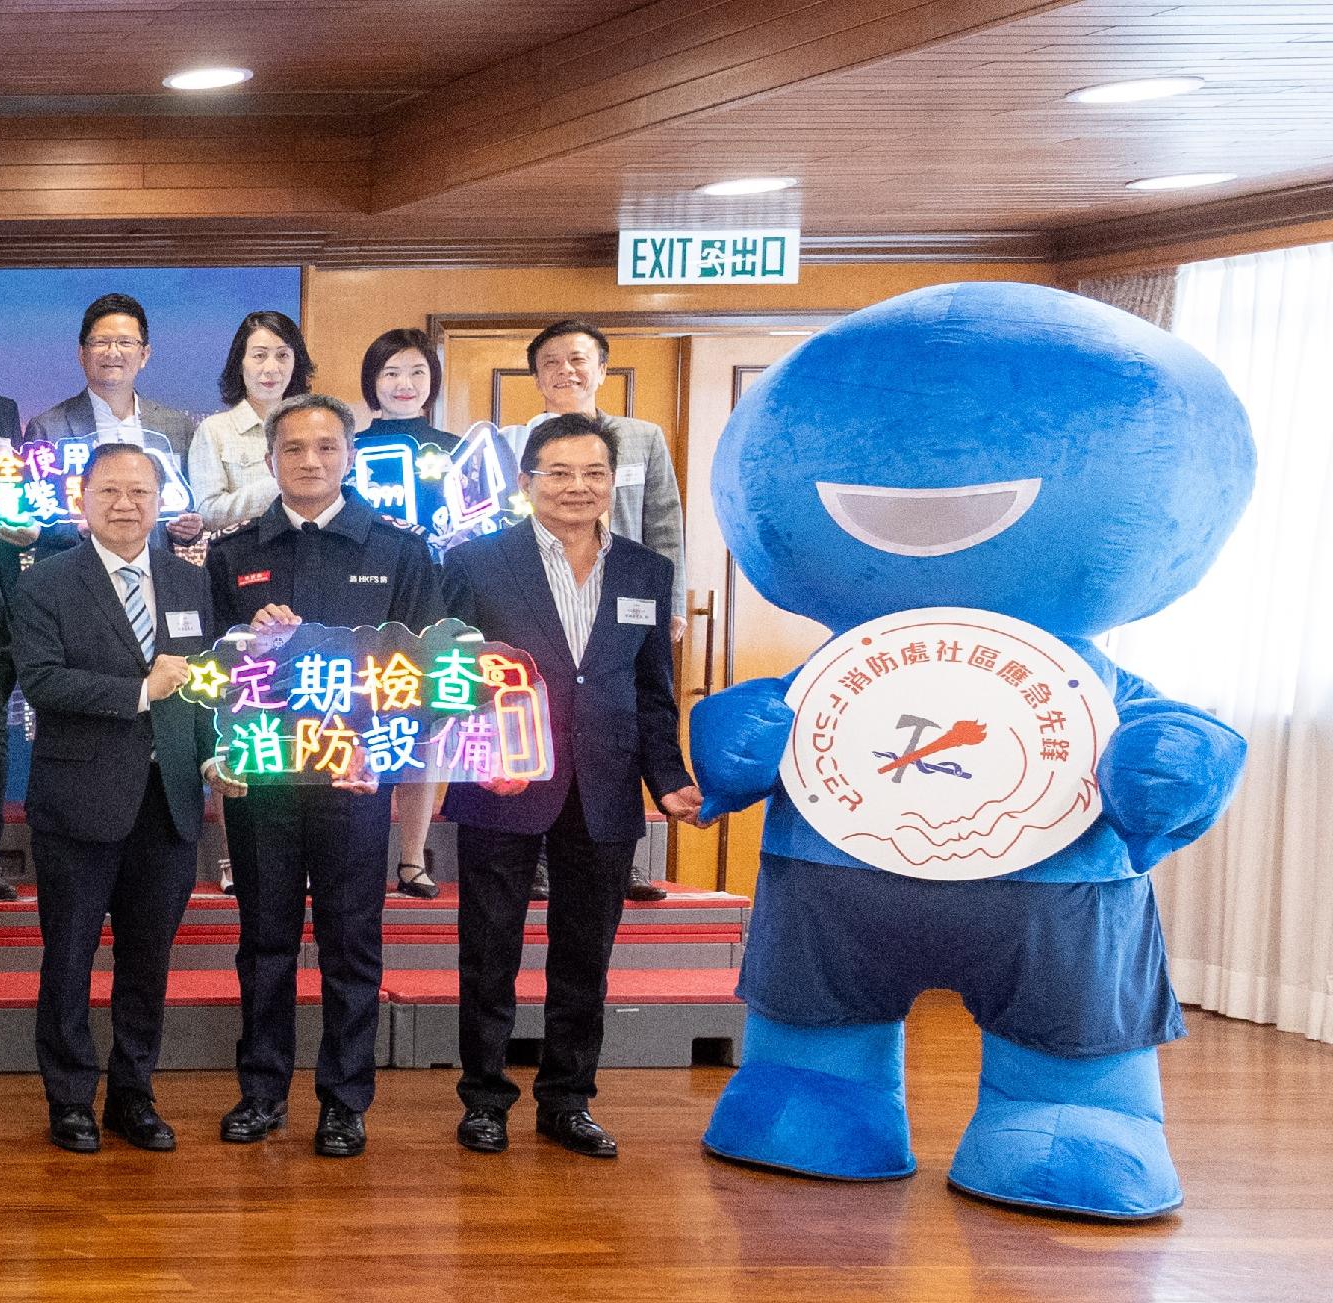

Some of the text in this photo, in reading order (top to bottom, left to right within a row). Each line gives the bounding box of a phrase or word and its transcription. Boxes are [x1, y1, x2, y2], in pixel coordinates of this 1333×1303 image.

[632, 236, 786, 278] EXIT 出口
[358, 575, 380, 584] HKFS
[230, 648, 485, 713] 定期檢查
[838, 639, 1071, 763] 消防處社區應急先鋒
[231, 713, 497, 775] 消防設備
